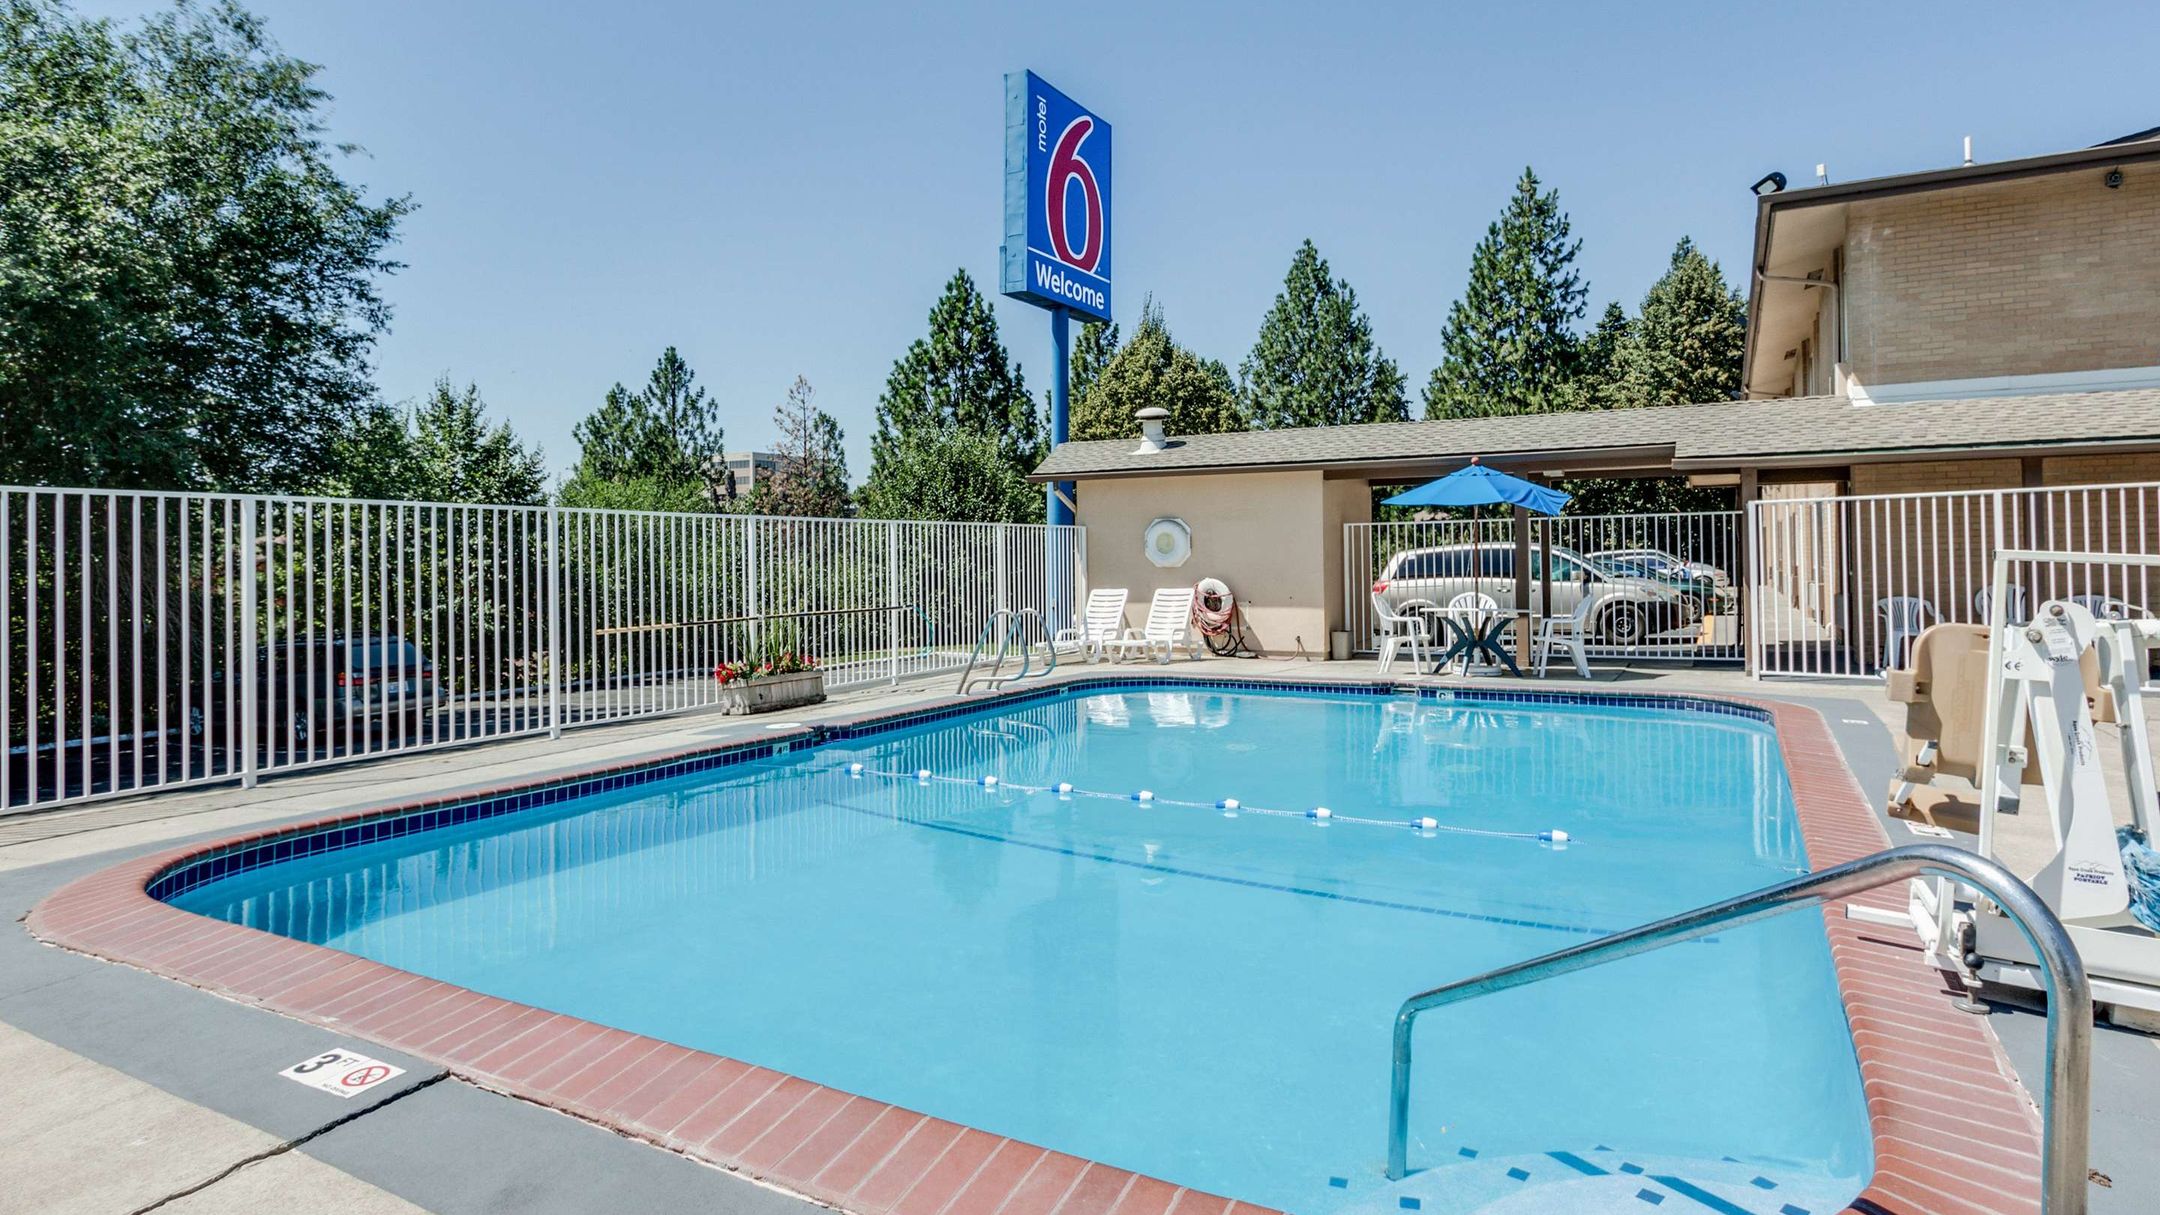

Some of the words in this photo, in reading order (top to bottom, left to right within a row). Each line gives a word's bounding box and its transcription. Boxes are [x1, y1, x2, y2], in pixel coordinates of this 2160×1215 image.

[1037, 95, 1047, 152] motel
[1045, 115, 1104, 275] 6
[1035, 260, 1105, 310] Welcome
[293, 1054, 342, 1074] 3
